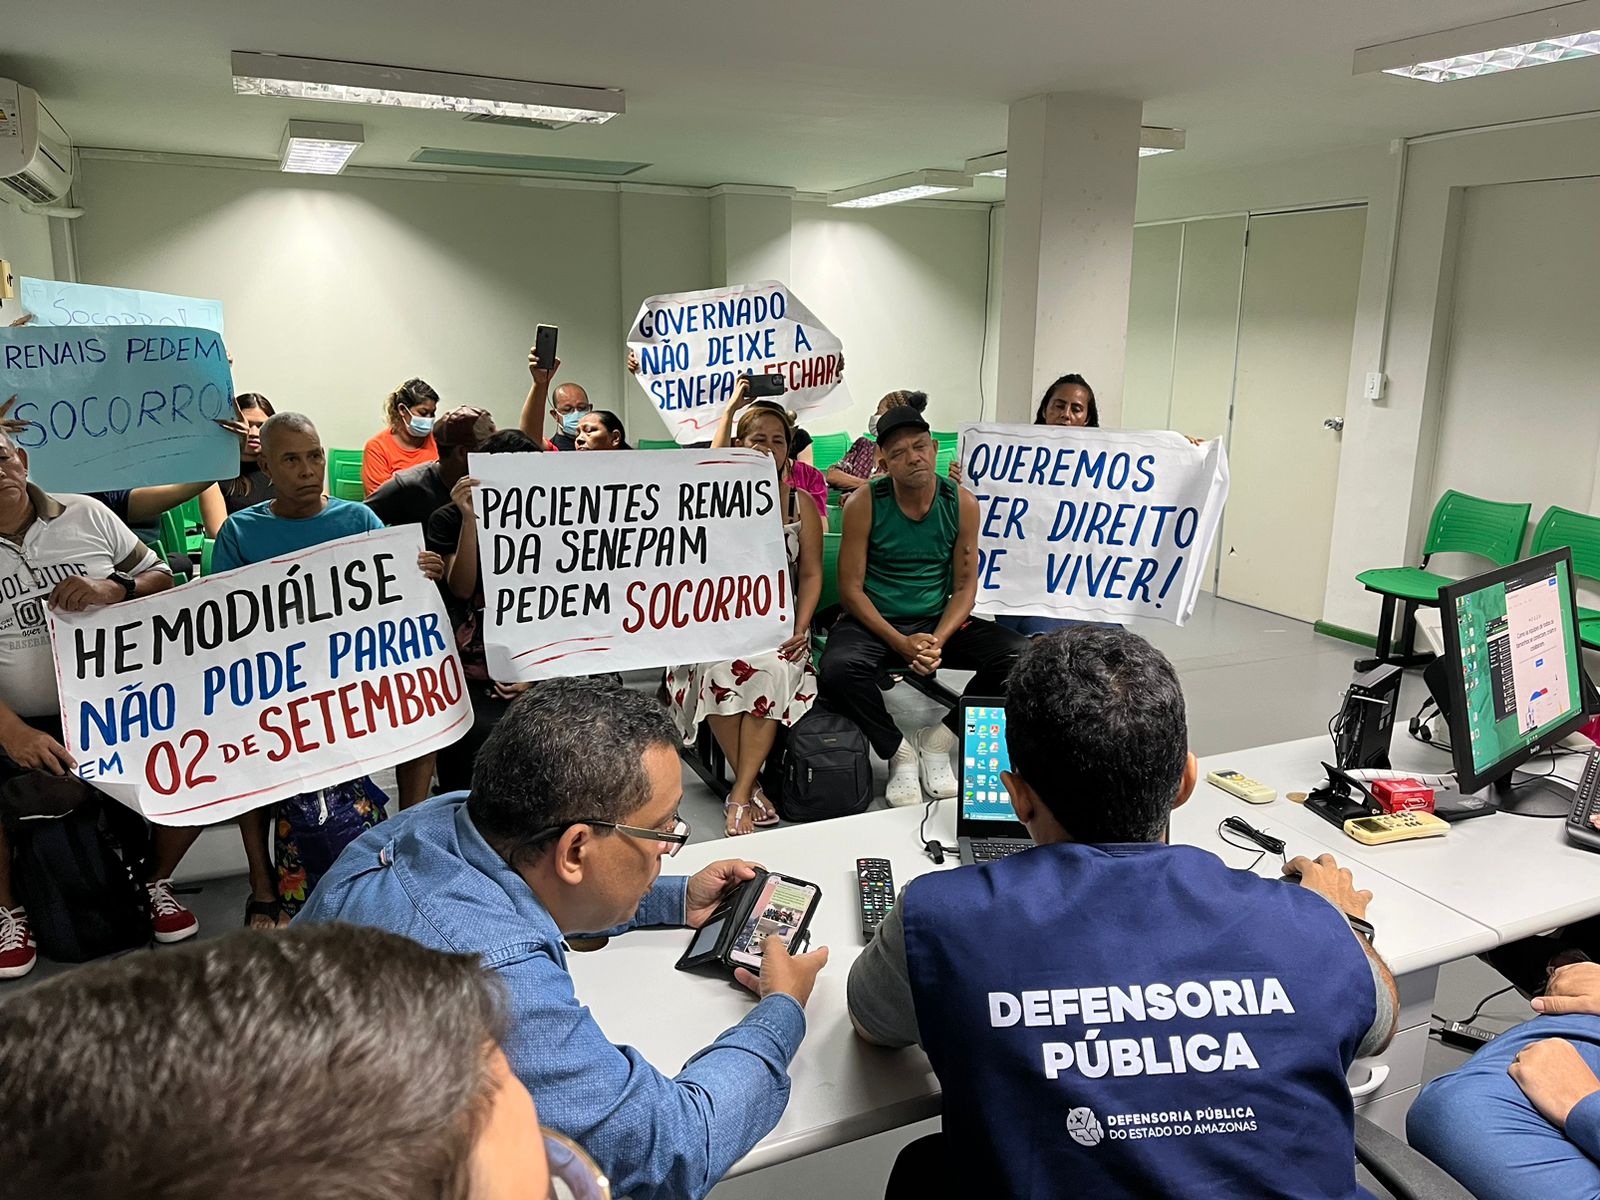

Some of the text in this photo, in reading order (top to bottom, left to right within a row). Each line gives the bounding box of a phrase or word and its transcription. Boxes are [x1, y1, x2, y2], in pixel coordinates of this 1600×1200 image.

[638, 291, 786, 339] GOVERNADO
[6, 336, 222, 370] RENAIS PEDEM
[641, 324, 813, 375] NÃO DEIXE A
[14, 380, 235, 449] SOCORRO!
[967, 442, 1156, 493] QUEREMOS
[480, 479, 774, 530] PACIENTES RENAIS
[975, 494, 1199, 549] ER DIREITO
[492, 525, 707, 575] DA SENEPAM
[495, 569, 787, 634] PEDEM SOCORRO!
[1047, 553, 1184, 609] VIVER!
[74, 553, 403, 680] HEMODIÁLISE
[79, 612, 447, 752] NÃO PODE PARAR
[78, 654, 462, 796] EM 02 DE SETEMBRO
[987, 977, 1296, 1028] DEFENSORIA
[1042, 1028, 1260, 1080] PÚBLICA
[1107, 1106, 1255, 1126] DEFENSORIA PÚBLICA
[1109, 1120, 1258, 1140] DO ESTADO DO AMAZONAS
